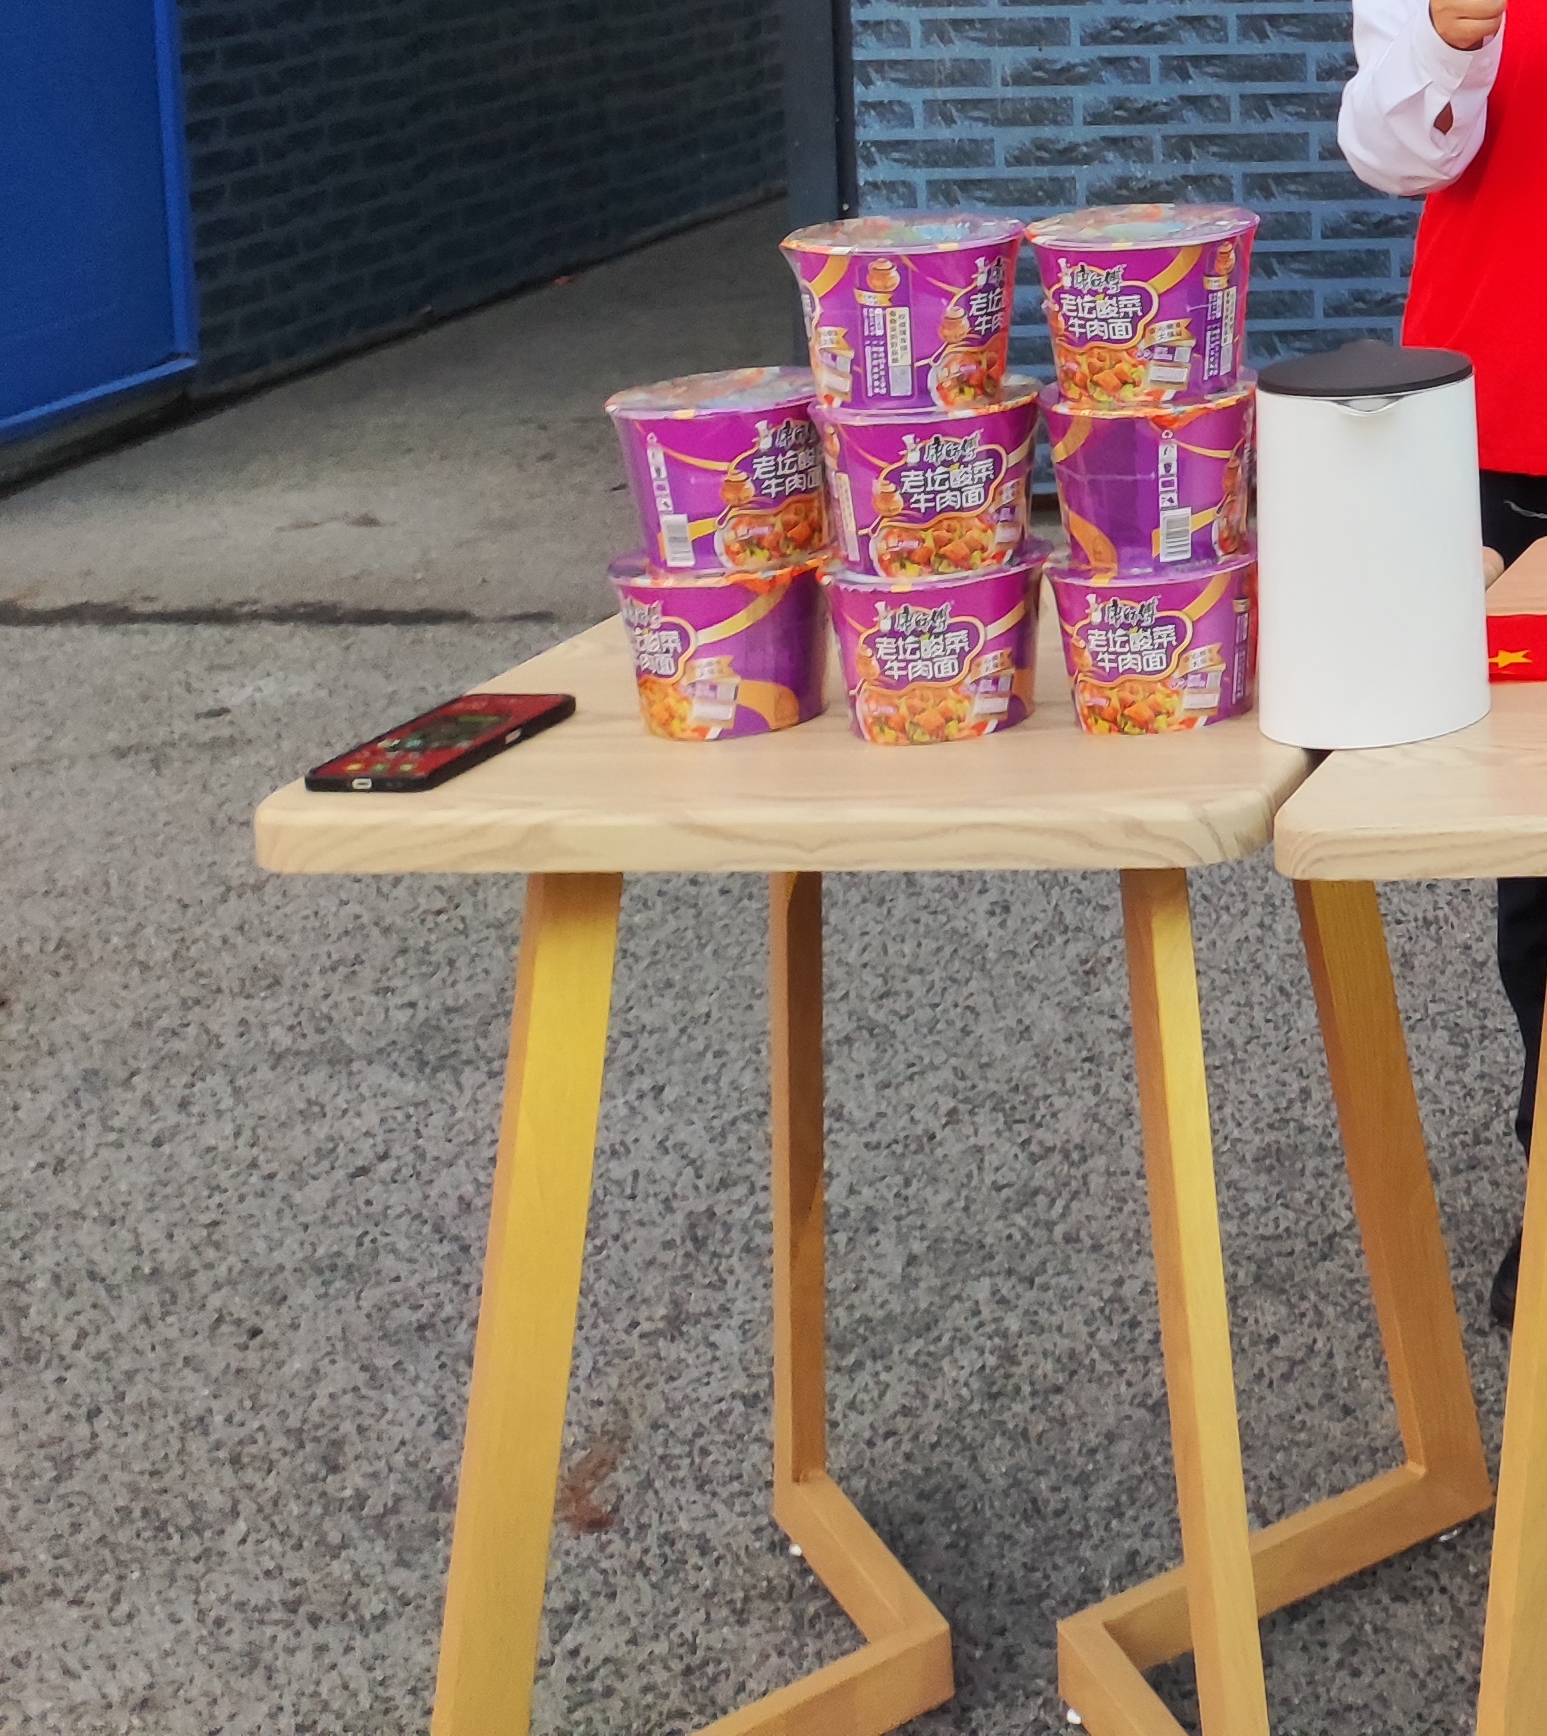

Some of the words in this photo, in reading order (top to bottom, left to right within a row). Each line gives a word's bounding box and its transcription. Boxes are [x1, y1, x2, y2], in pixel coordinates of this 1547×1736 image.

[1060, 293, 1142, 318] 老坛酸菜
[1067, 318, 1132, 340] 牛肉面
[900, 458, 994, 493] 老坛酸菜
[910, 485, 984, 513] 牛肉面
[875, 630, 970, 660] 老坛酸菜
[1087, 625, 1178, 652] 老坛酸菜
[884, 655, 959, 681] 牛肉面
[1096, 649, 1167, 673] 牛肉面
